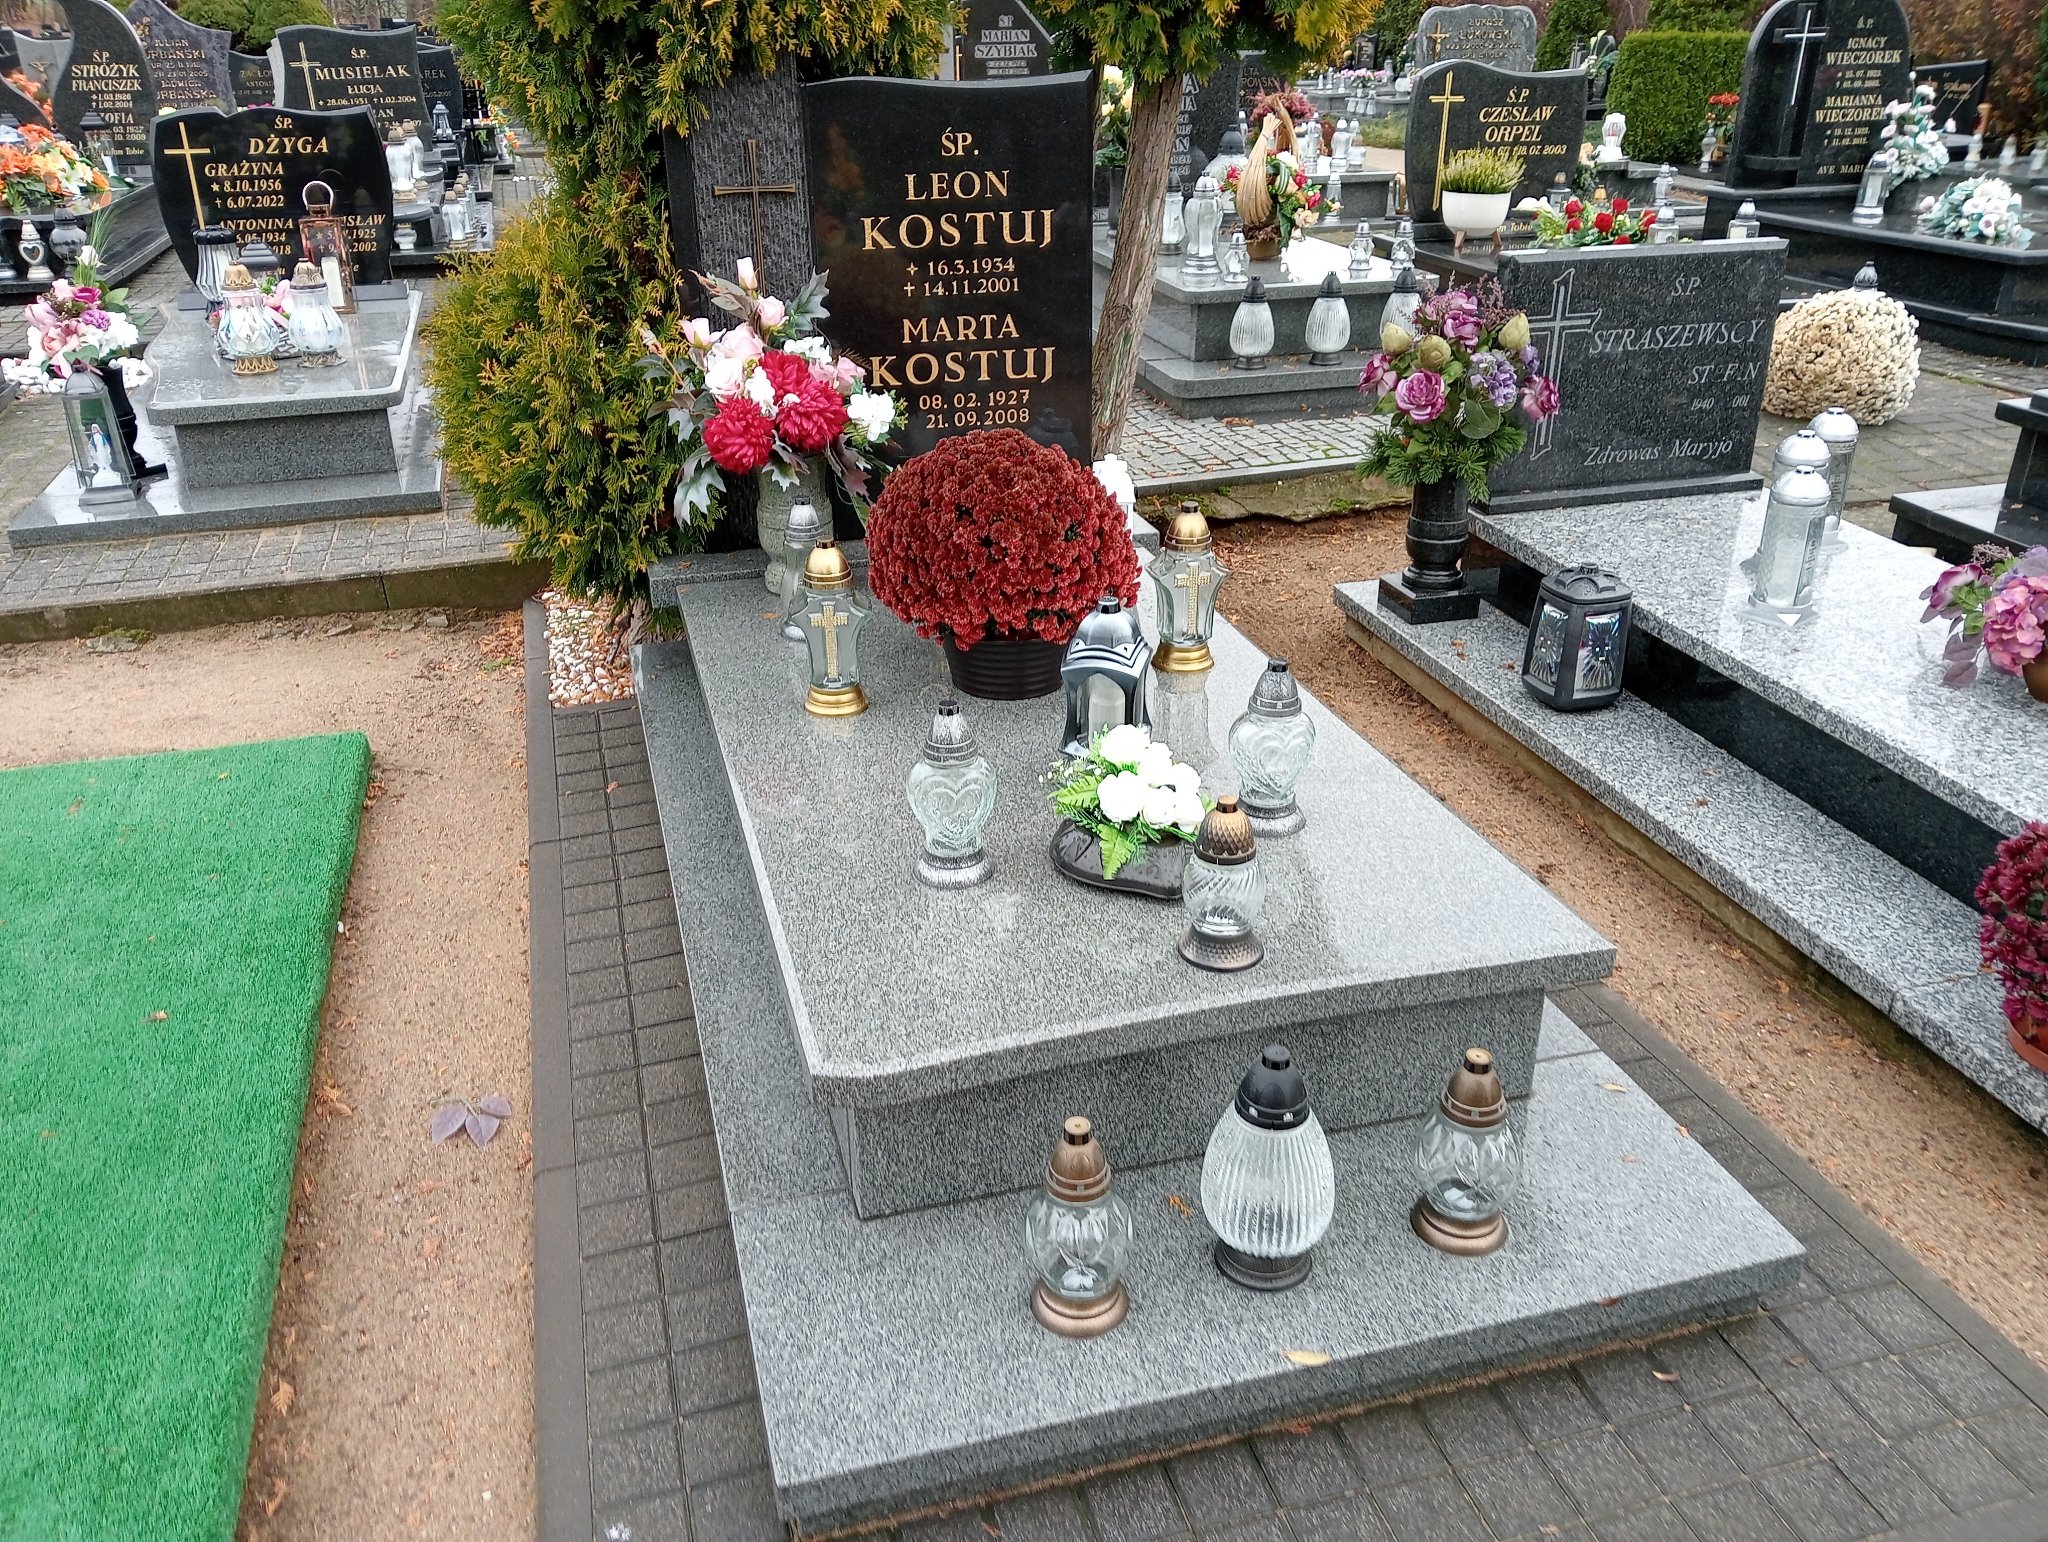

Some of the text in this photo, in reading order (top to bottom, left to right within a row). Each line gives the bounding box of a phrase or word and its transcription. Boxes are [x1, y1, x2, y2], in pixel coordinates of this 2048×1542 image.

[982, 29, 1030, 42] MARIAN
[1847, 37, 1888, 49] IGNACY
[975, 44, 1037, 58] SZYBIAK
[1826, 50, 1903, 66] WIECZOREK
[71, 62, 139, 77] STRÓŻYK
[315, 64, 411, 81] MUSIELAK
[72, 79, 142, 91] FRANCISZEK
[347, 84, 383, 94] ŁUCJA
[1825, 94, 1882, 107] MARIANNA
[274, 115, 293, 129] ŚP.
[1479, 105, 1557, 122] CZESŁAW
[1815, 107, 1888, 123] WIECZOREK
[1485, 125, 1543, 142] ORPEL
[248, 134, 329, 155] DŻYGA
[941, 127, 979, 158] ŚP.
[204, 160, 285, 177] GRAŻYNA
[1816, 165, 1865, 175] AVE MARI
[223, 179, 282, 193] 8.10.1956
[905, 170, 1011, 200] LEON
[226, 195, 285, 209] 6.07.2022
[860, 208, 1055, 251] KOSTUJ
[1510, 222, 1533, 232] Tobie
[928, 257, 1016, 276] 16.3.1934
[923, 277, 1020, 297] 14.11.2001
[902, 313, 1020, 344] MARTA
[1589, 319, 1766, 354] STRASZEWSCY
[869, 346, 1056, 387] KOSTUJ
[1688, 361, 1762, 385] STFN
[988, 389, 1030, 407] 1927
[1690, 396, 1715, 411] 1940
[1669, 438, 1733, 464] Maryjo
